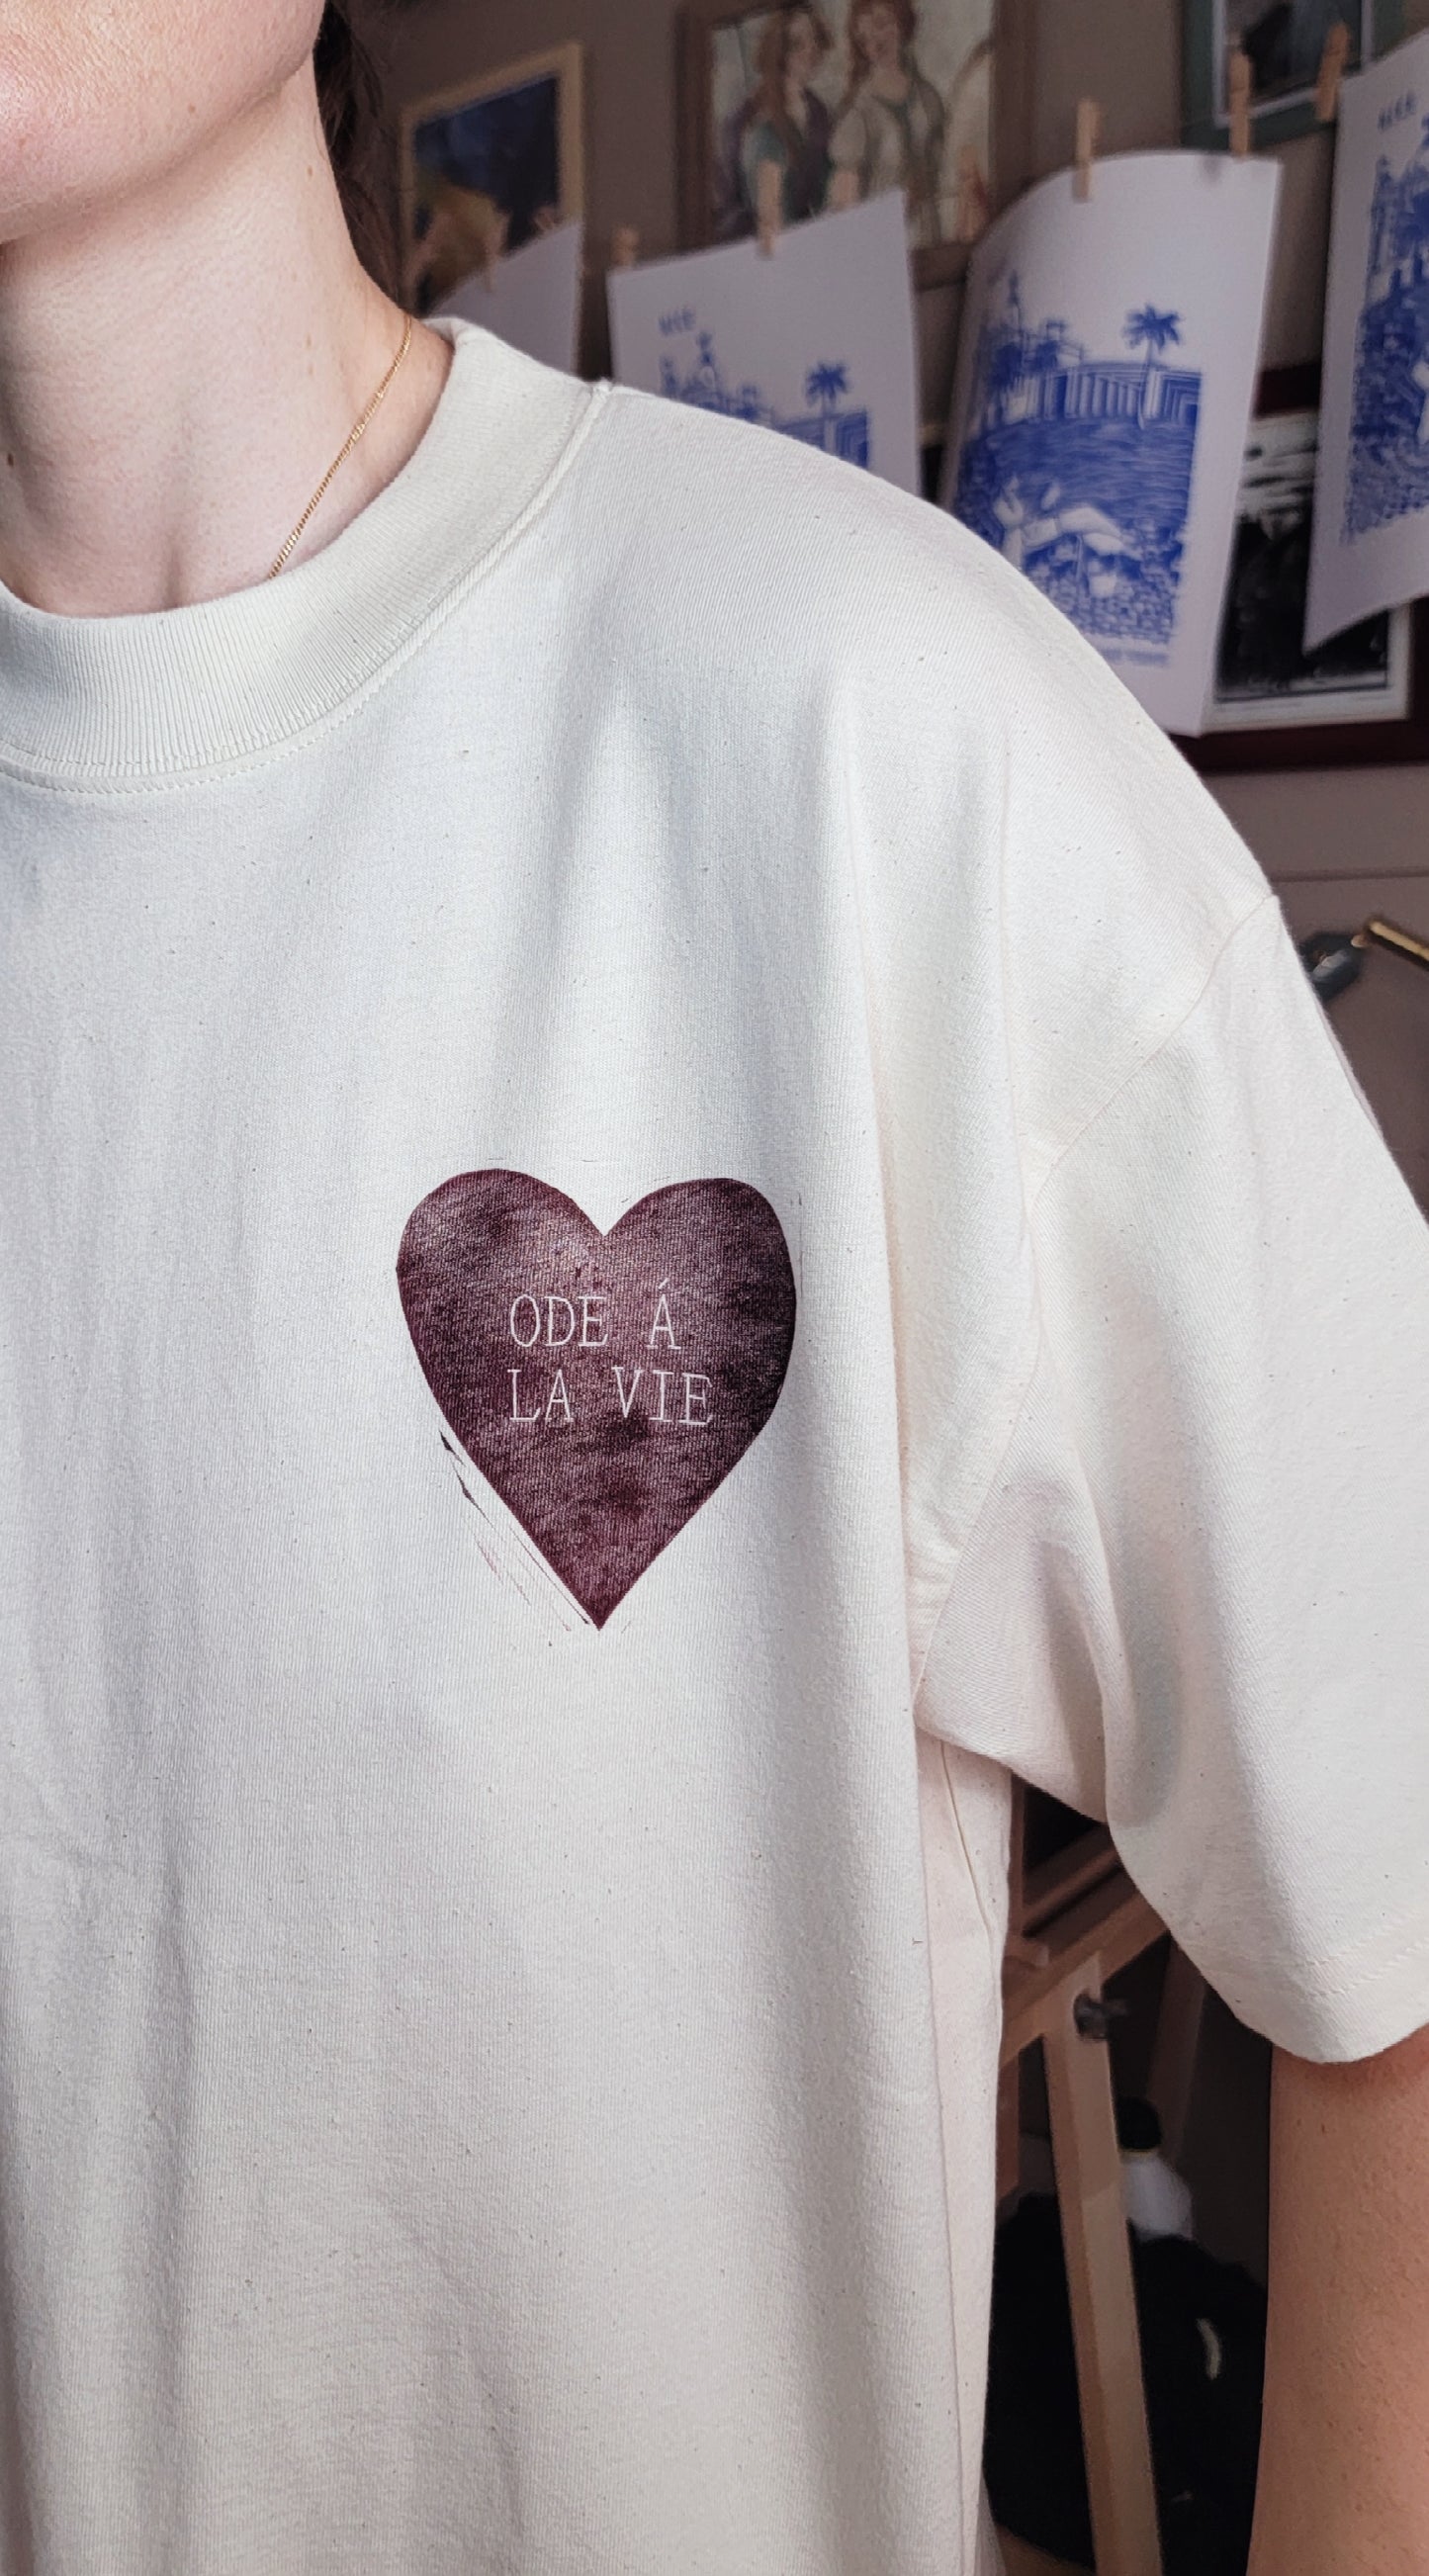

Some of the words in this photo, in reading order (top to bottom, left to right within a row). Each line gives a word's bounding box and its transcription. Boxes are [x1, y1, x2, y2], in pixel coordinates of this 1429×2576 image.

[510, 1293, 608, 1347] ODE
[646, 1278, 681, 1349] Á
[507, 1369, 575, 1422] LA
[611, 1366, 713, 1426] VIE
